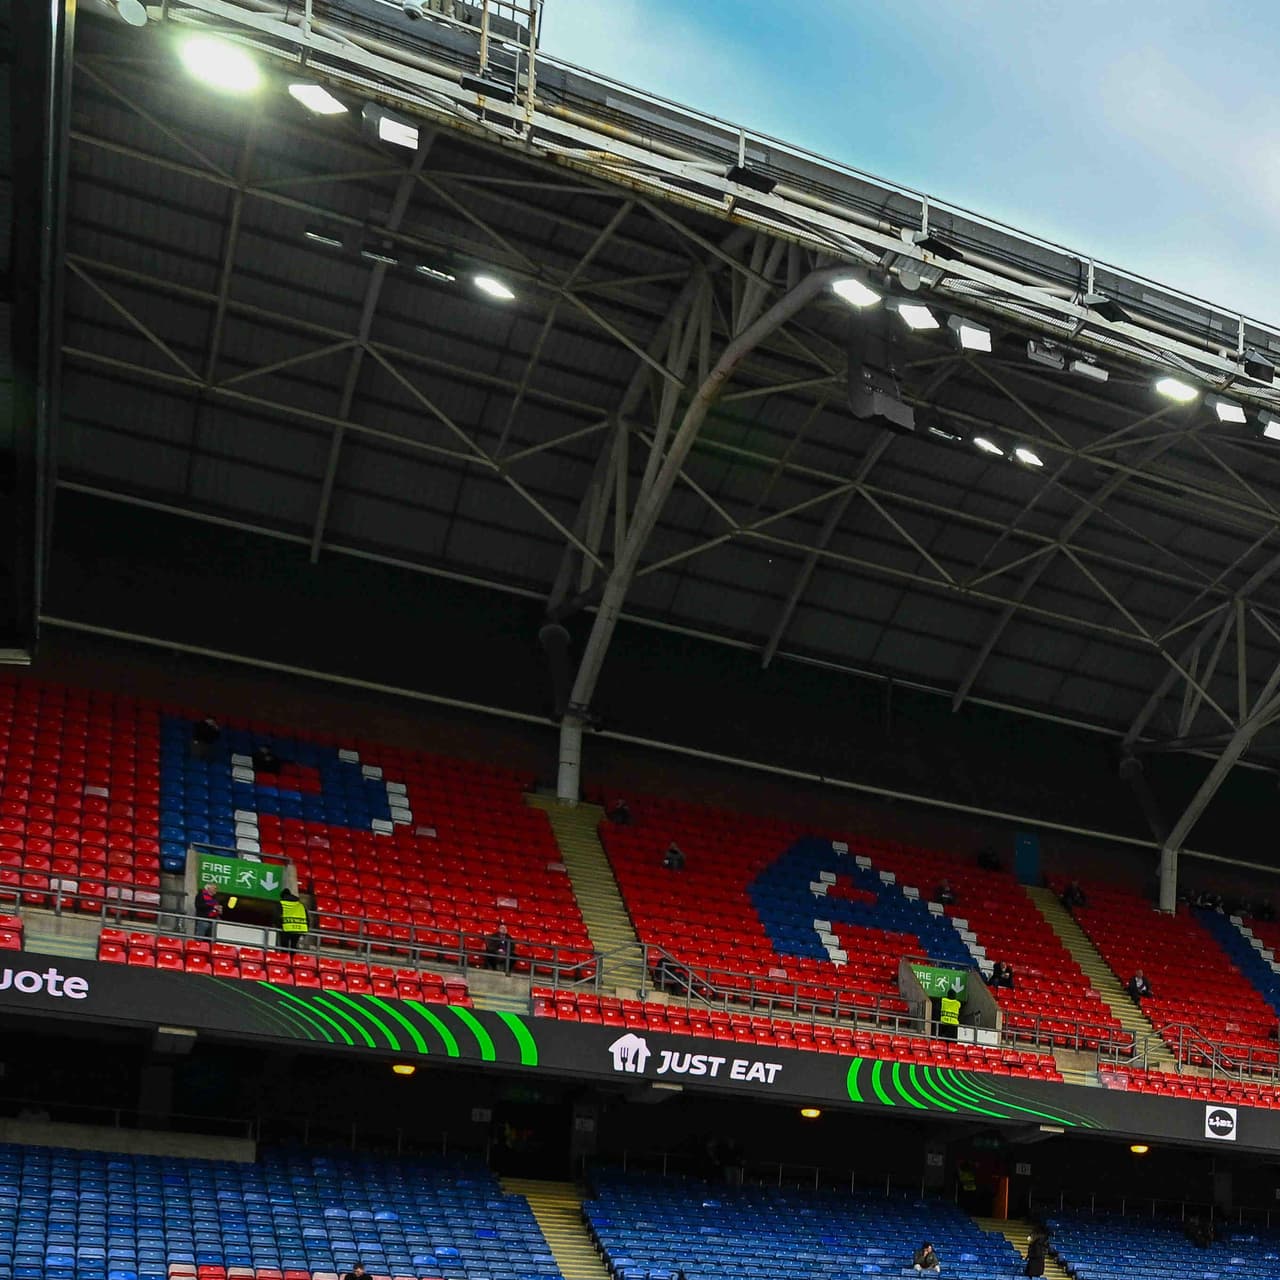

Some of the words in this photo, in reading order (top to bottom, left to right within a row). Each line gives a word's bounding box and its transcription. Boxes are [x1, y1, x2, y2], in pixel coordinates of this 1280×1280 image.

[202, 862, 232, 874] FIRE
[202, 872, 231, 885] EXIT
[656, 1050, 726, 1077] JUST
[729, 1059, 783, 1084] EAT
